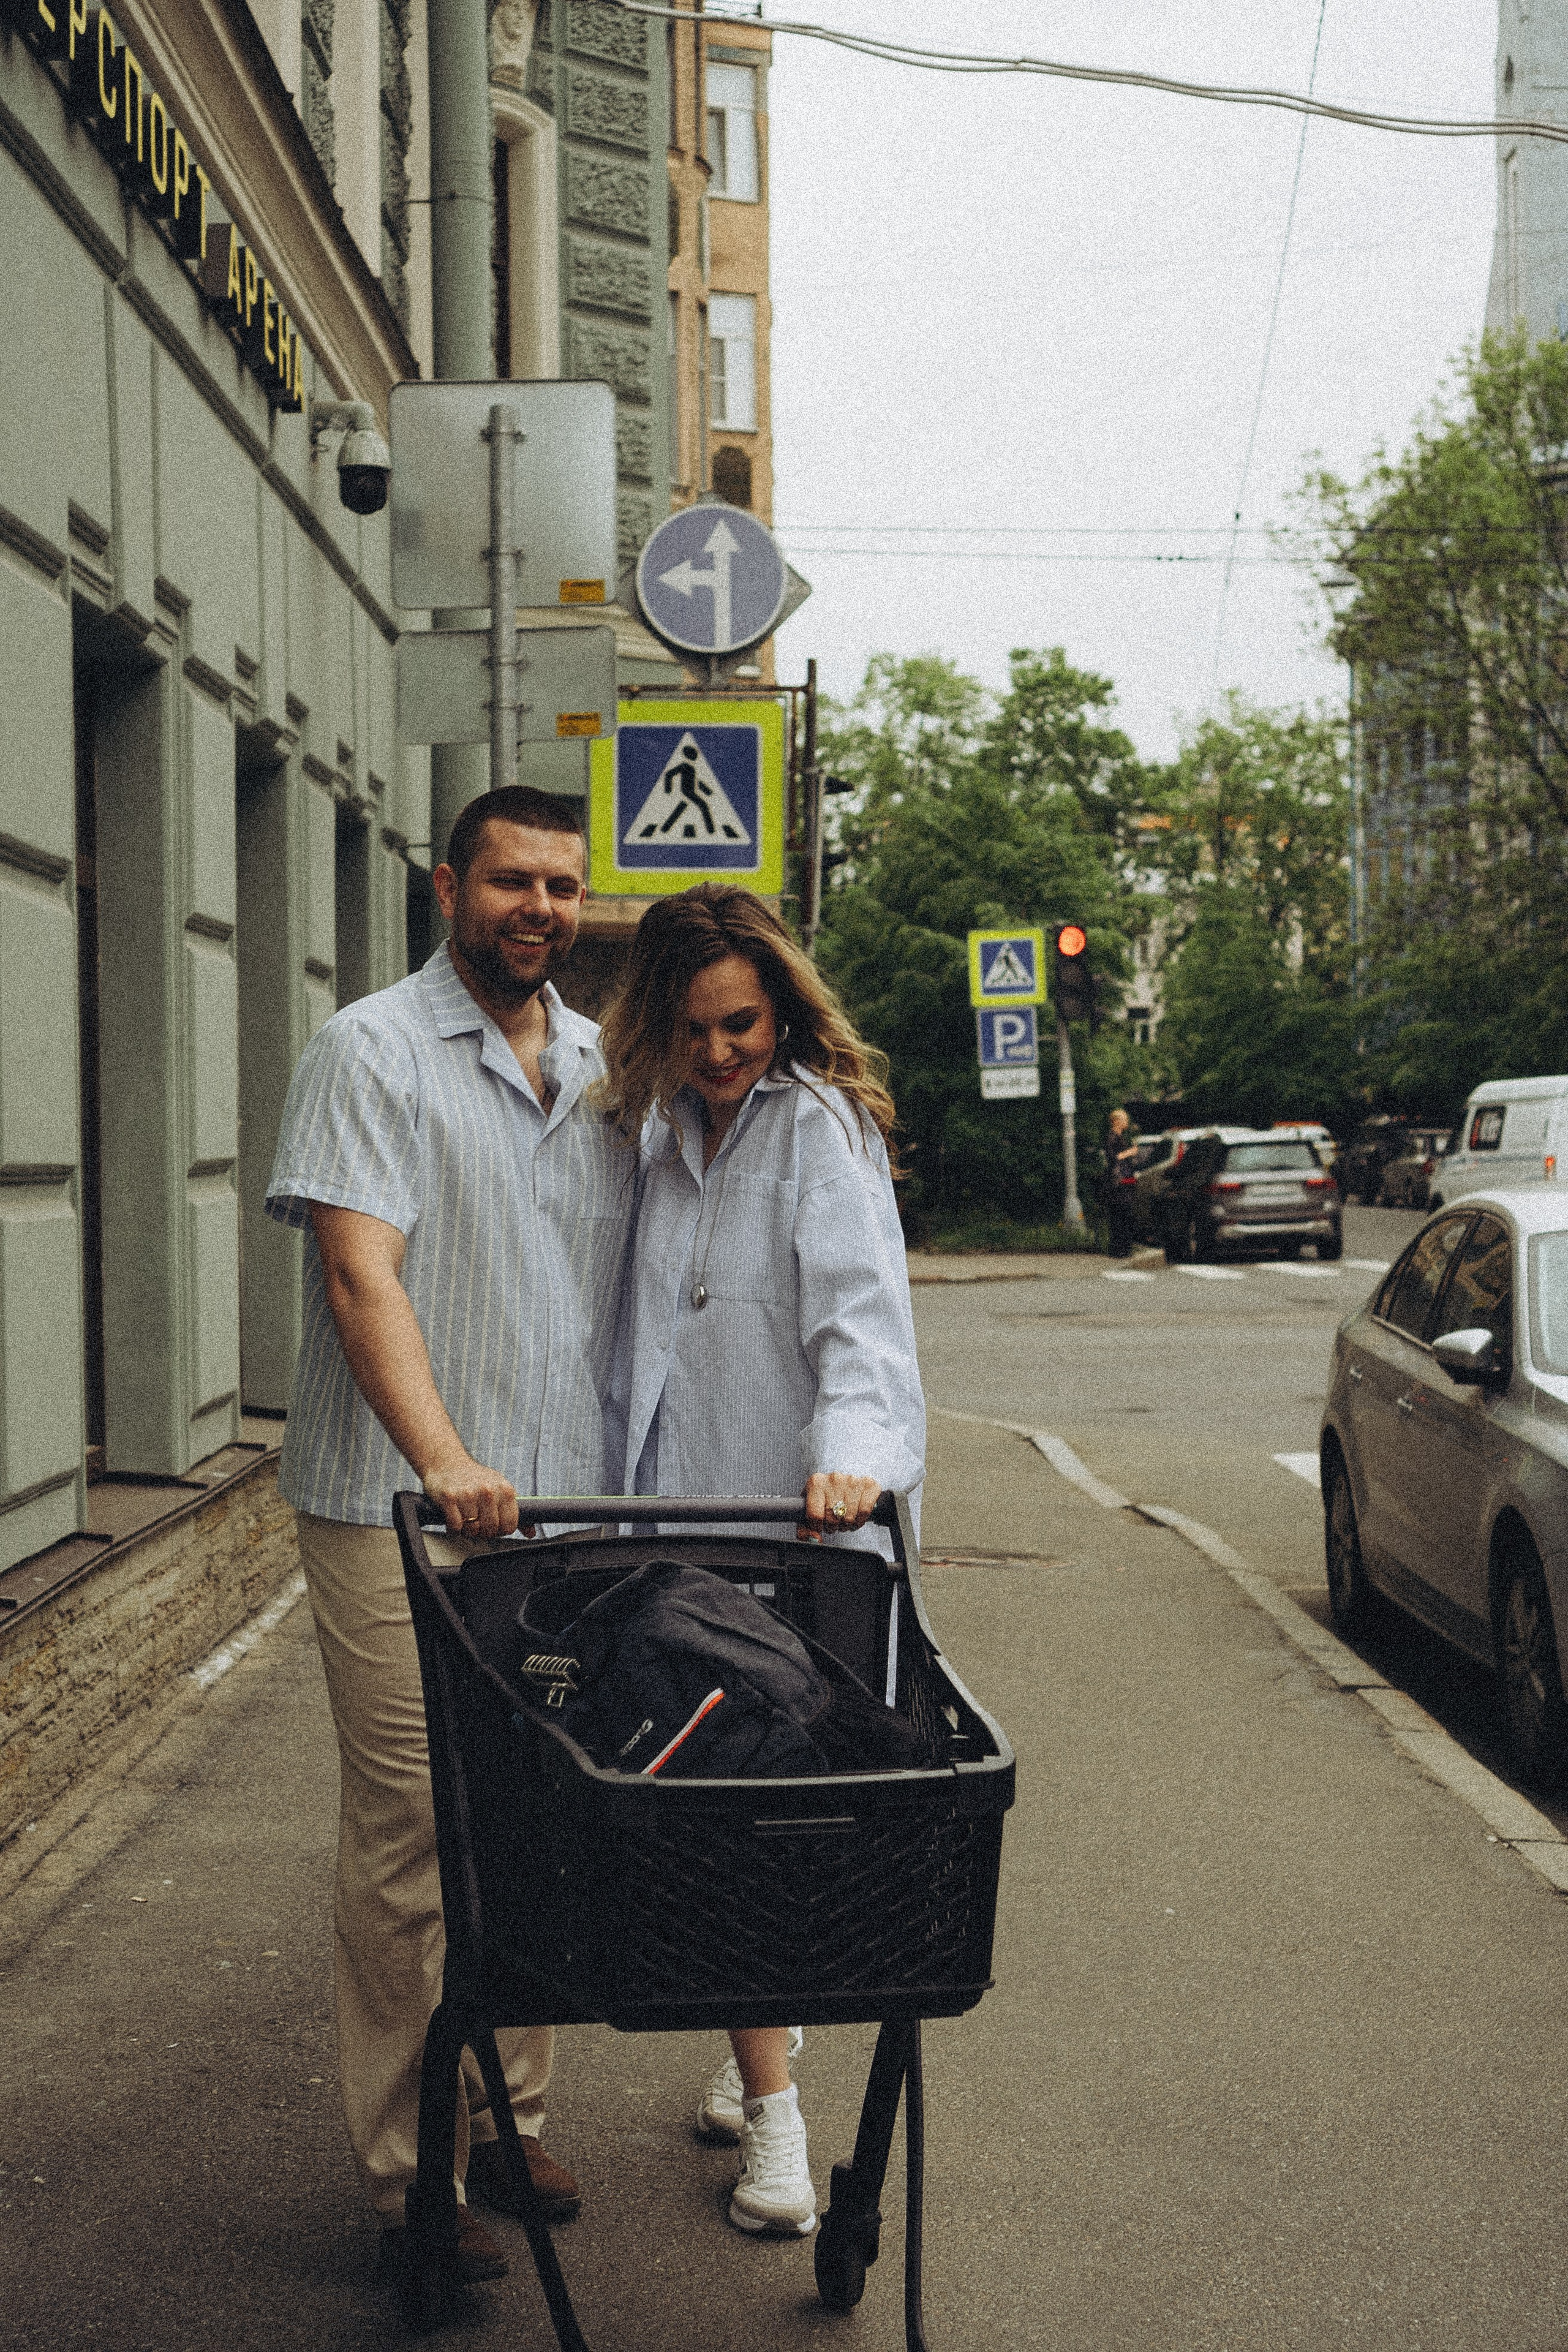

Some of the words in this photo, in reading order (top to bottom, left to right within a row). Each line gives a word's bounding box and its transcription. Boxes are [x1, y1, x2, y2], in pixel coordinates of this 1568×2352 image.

[38, 0, 210, 259] РСПОРТ
[228, 223, 304, 413] АРЕНА
[993, 1014, 1026, 1060] P
